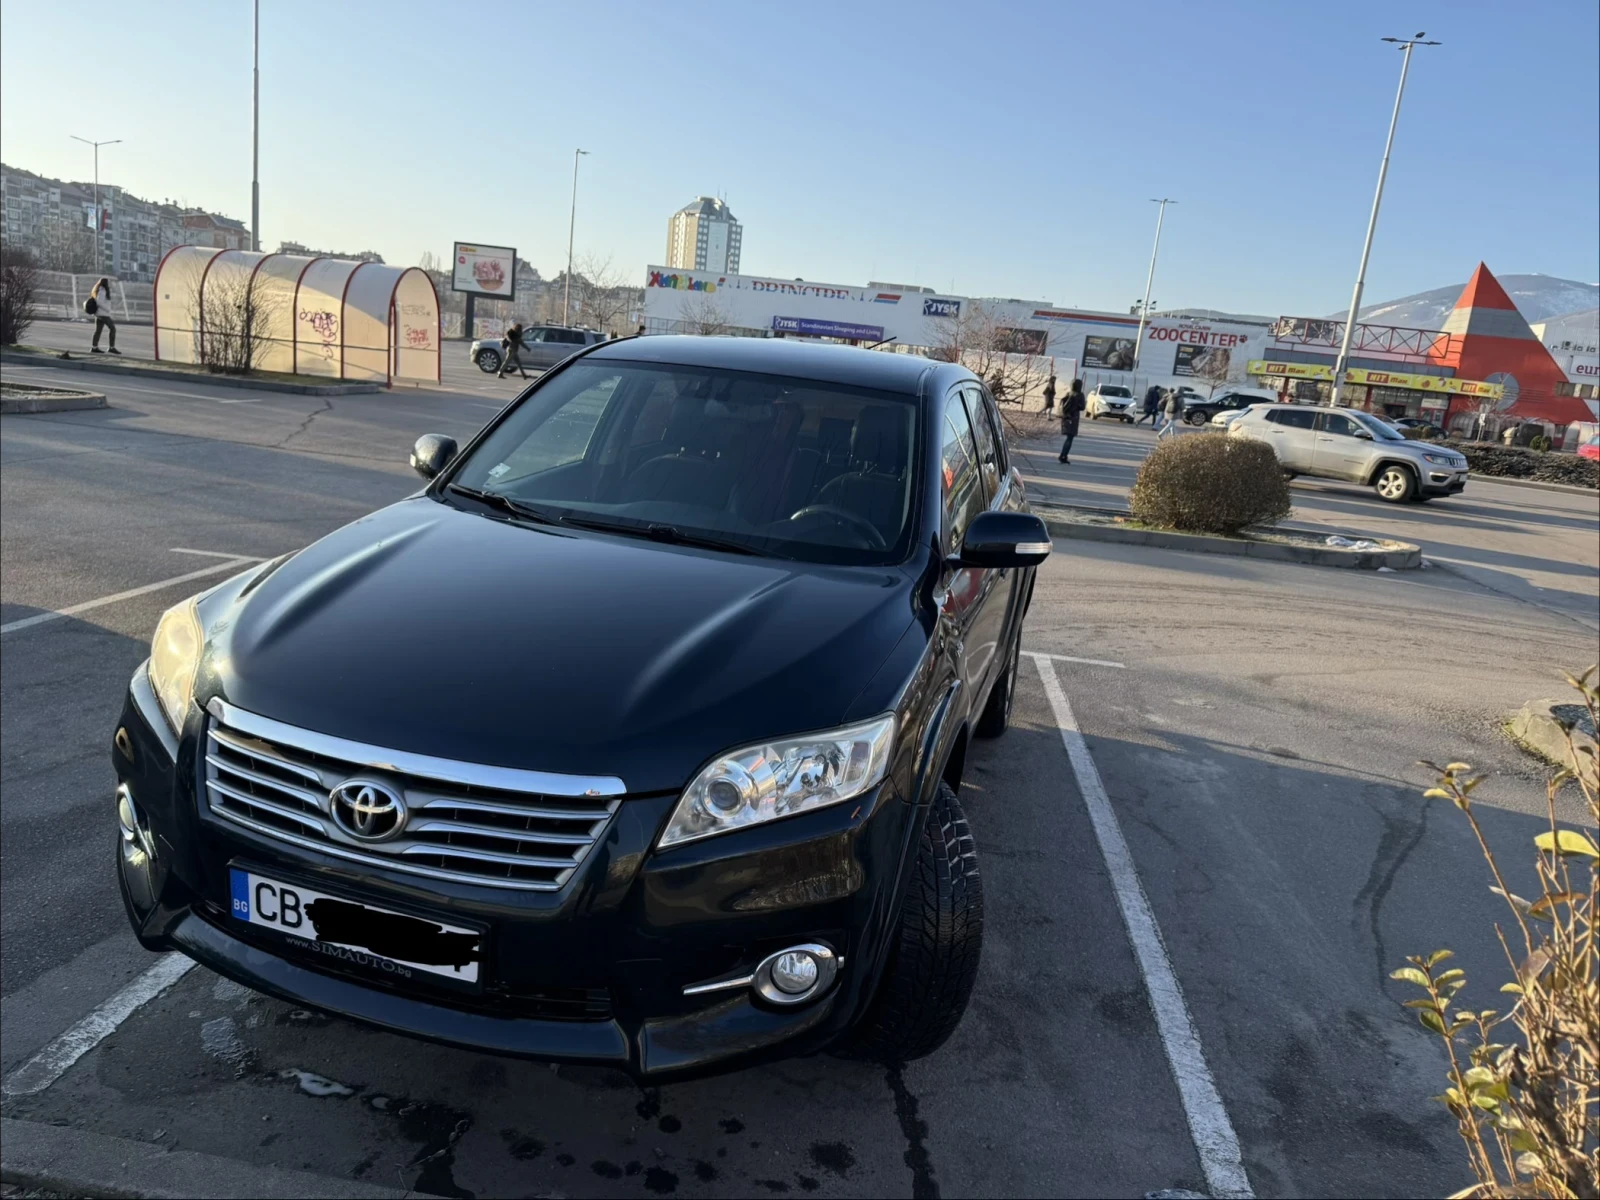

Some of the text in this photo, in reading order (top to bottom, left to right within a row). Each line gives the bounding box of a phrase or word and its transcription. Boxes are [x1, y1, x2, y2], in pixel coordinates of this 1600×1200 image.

[930, 303, 959, 314] JYSK
[780, 320, 798, 328] JYSK
[801, 322, 834, 331] Scandinavian
[834, 326, 855, 334] Sleeping
[865, 329, 881, 337] Living
[1149, 327, 1238, 347] ZOOCENTER
[1268, 365, 1285, 373] HIT
[1368, 373, 1388, 383] HIT
[1462, 384, 1477, 393] HIT
[233, 898, 248, 913] BG
[255, 882, 302, 929] CB
[285, 935, 412, 978] www.SIMAUTO.bg
